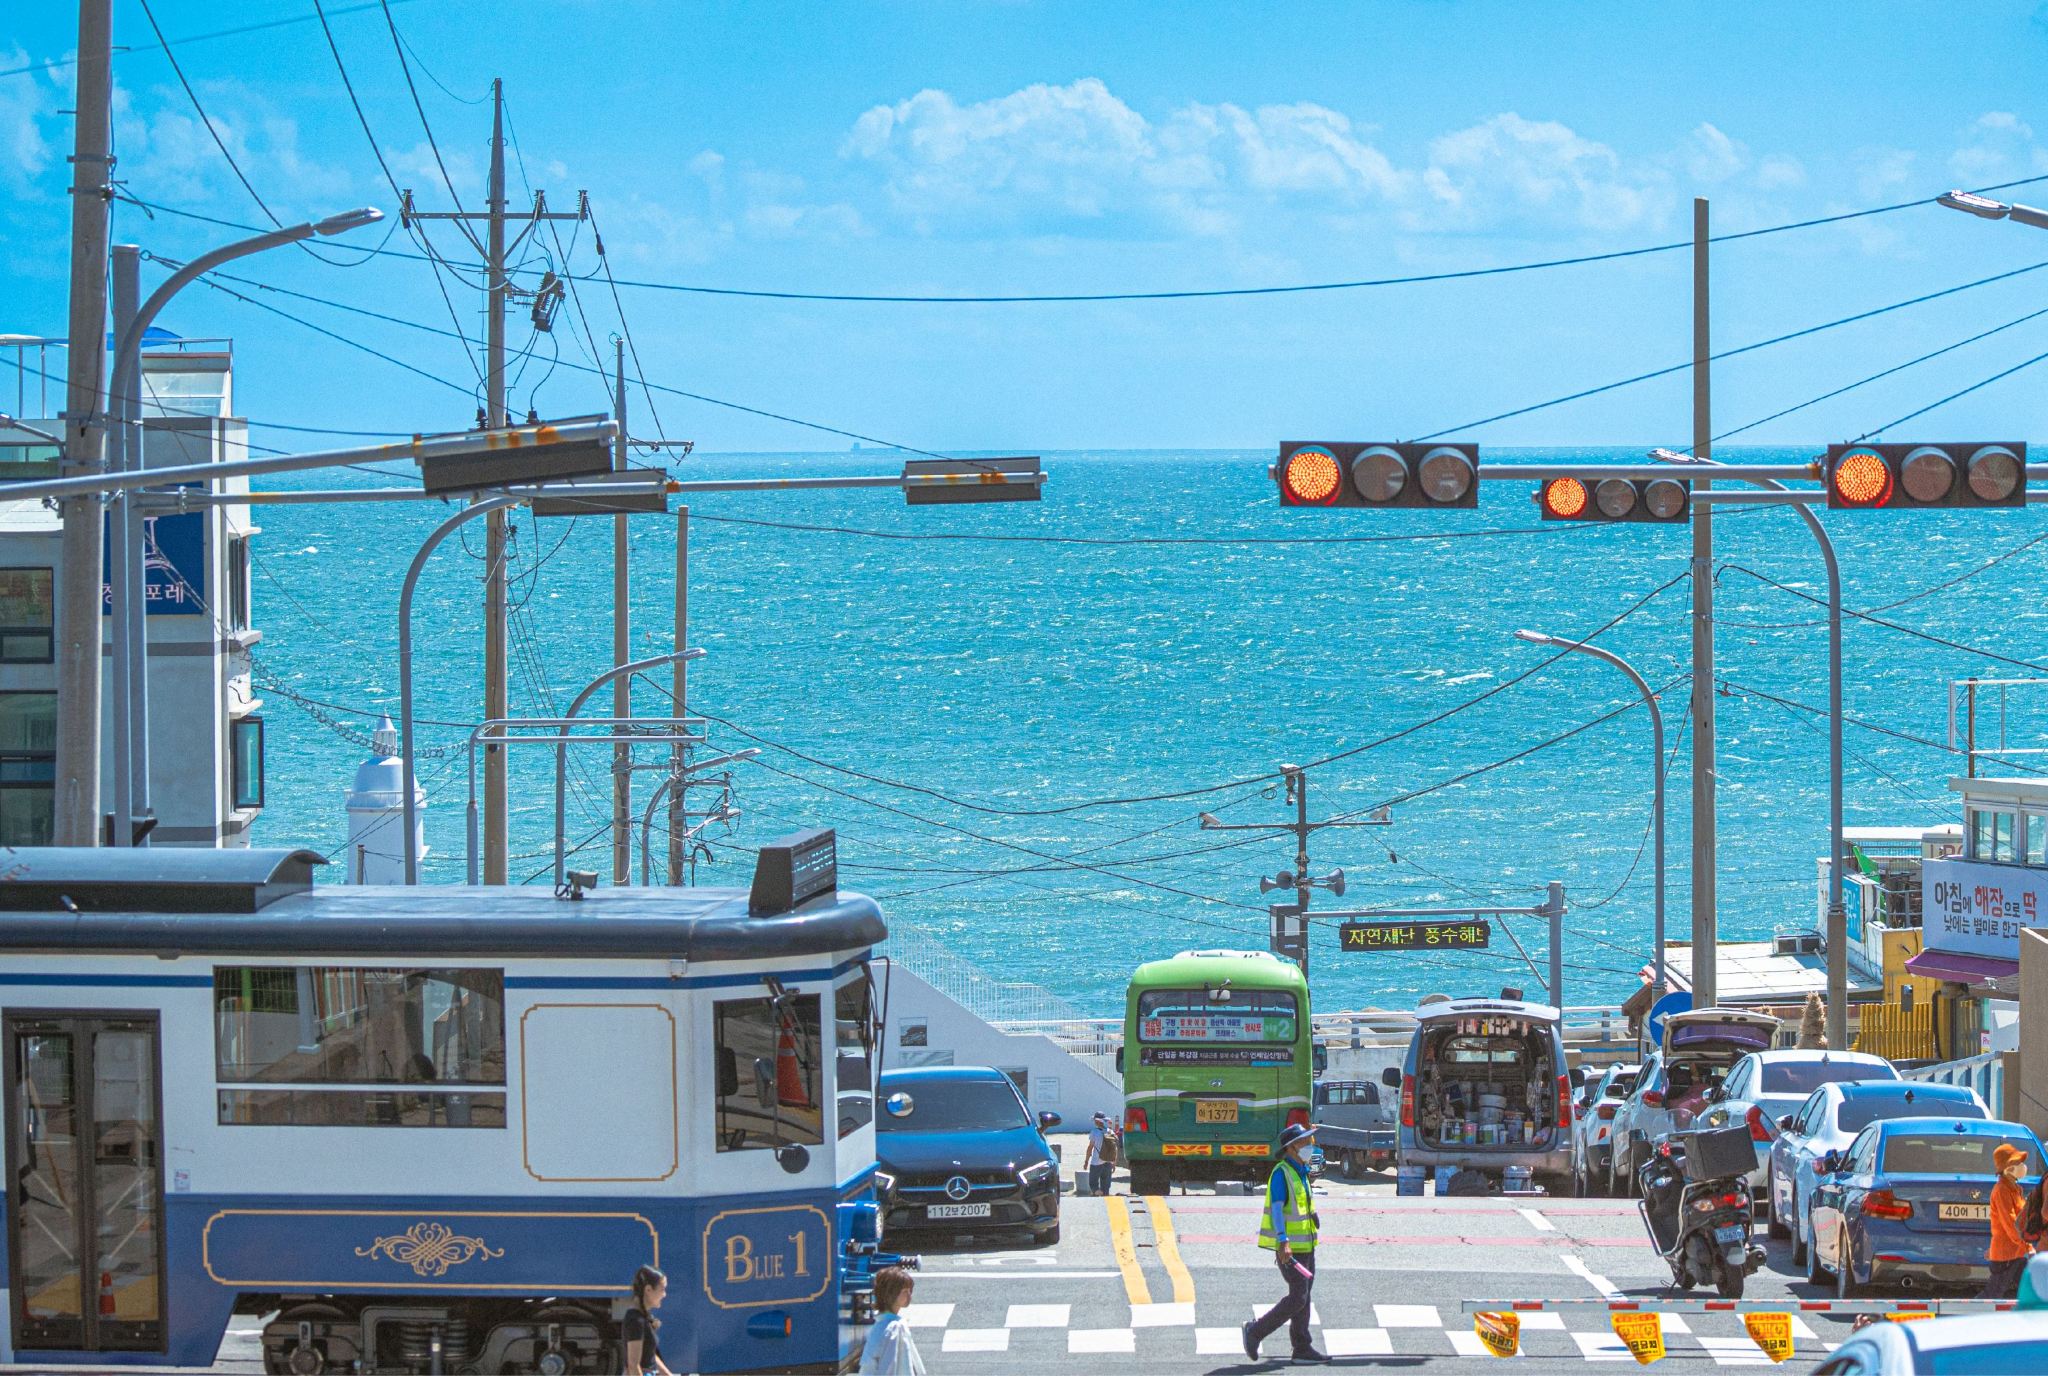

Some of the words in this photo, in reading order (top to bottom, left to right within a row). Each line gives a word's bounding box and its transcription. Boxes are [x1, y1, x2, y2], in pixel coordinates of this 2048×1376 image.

[1934, 881, 1972, 914] 아침에
[1975, 886, 2021, 918] 해장으로
[2023, 891, 2037, 922] 딱
[1944, 915, 1970, 934] 낮에는
[1974, 918, 1999, 936] 별미로
[1349, 927, 1415, 945] 자연재난
[1279, 1020, 1290, 1037] 2
[932, 1204, 987, 1217] 112보2007
[788, 1231, 810, 1277] 1
